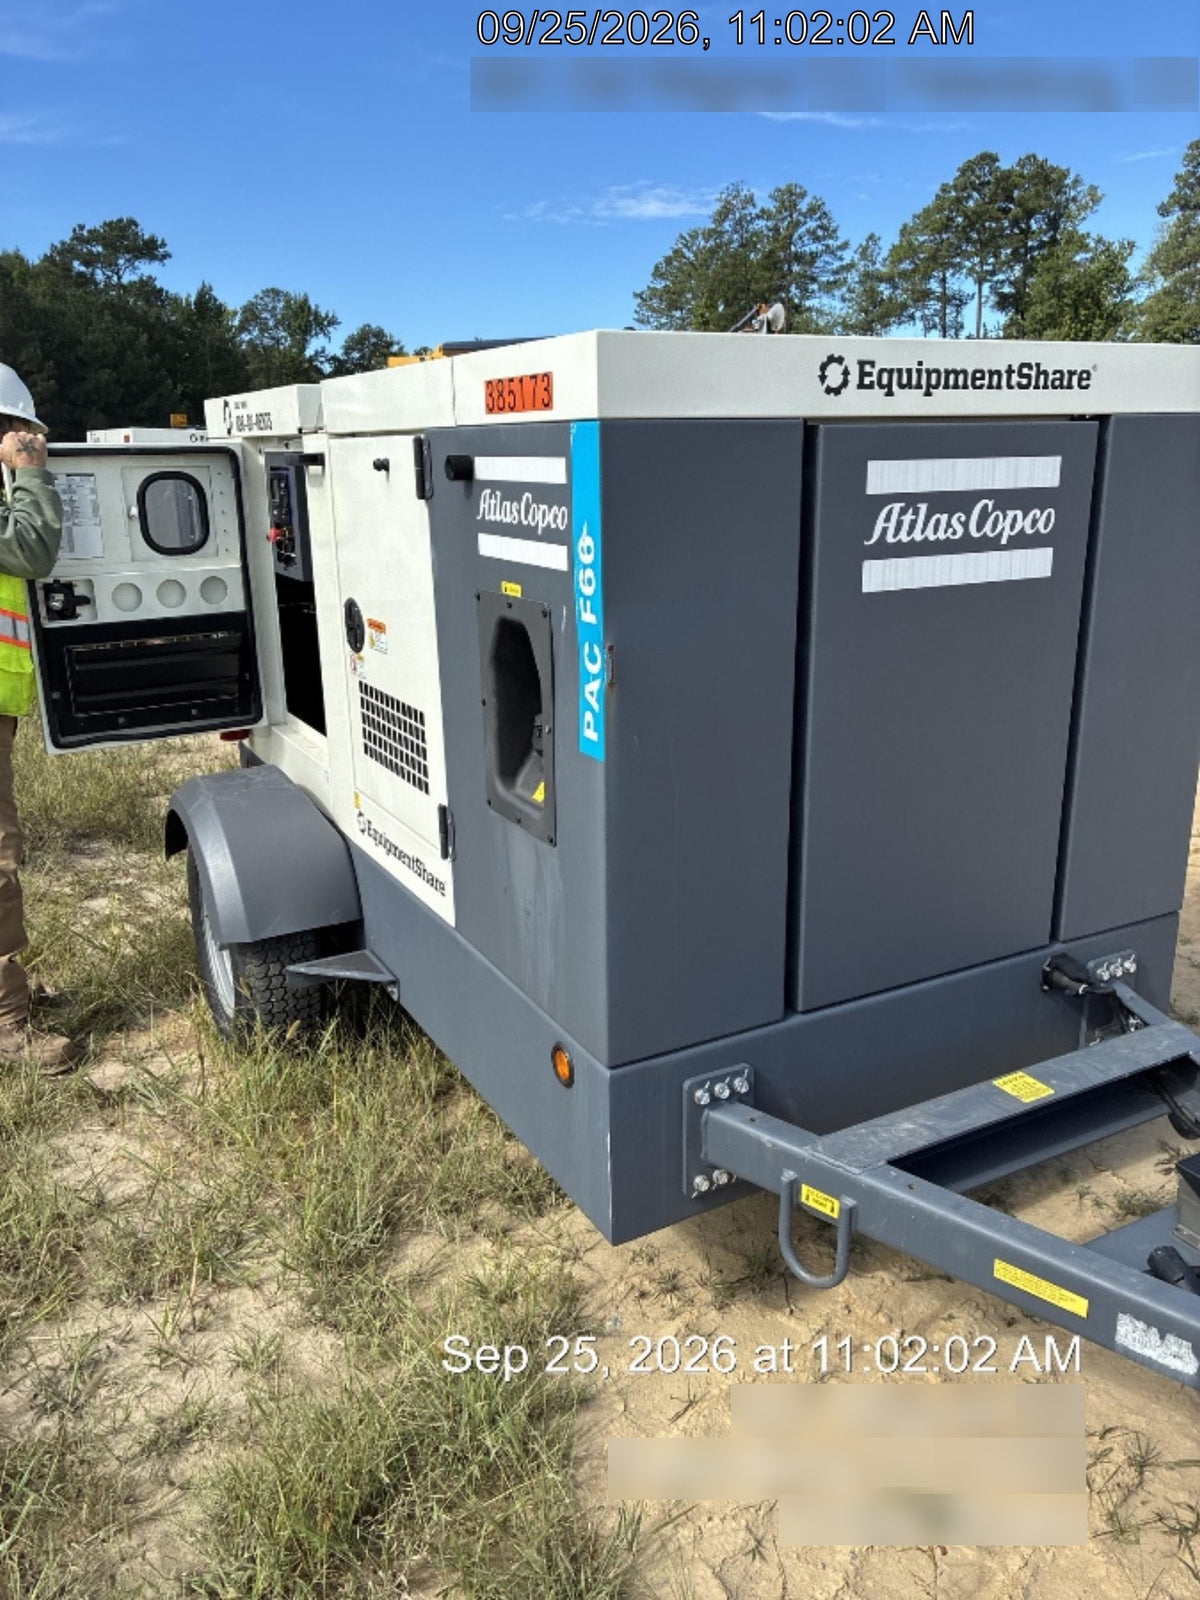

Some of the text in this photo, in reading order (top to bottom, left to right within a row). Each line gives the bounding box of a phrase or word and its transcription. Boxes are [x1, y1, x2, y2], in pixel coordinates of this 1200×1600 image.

[486, 373, 550, 412] 385173
[857, 359, 1091, 397] EquipmentShare
[476, 488, 568, 536] Atlas Copco
[864, 499, 1056, 545] Atlas Copco
[577, 535, 601, 743] PAC F66
